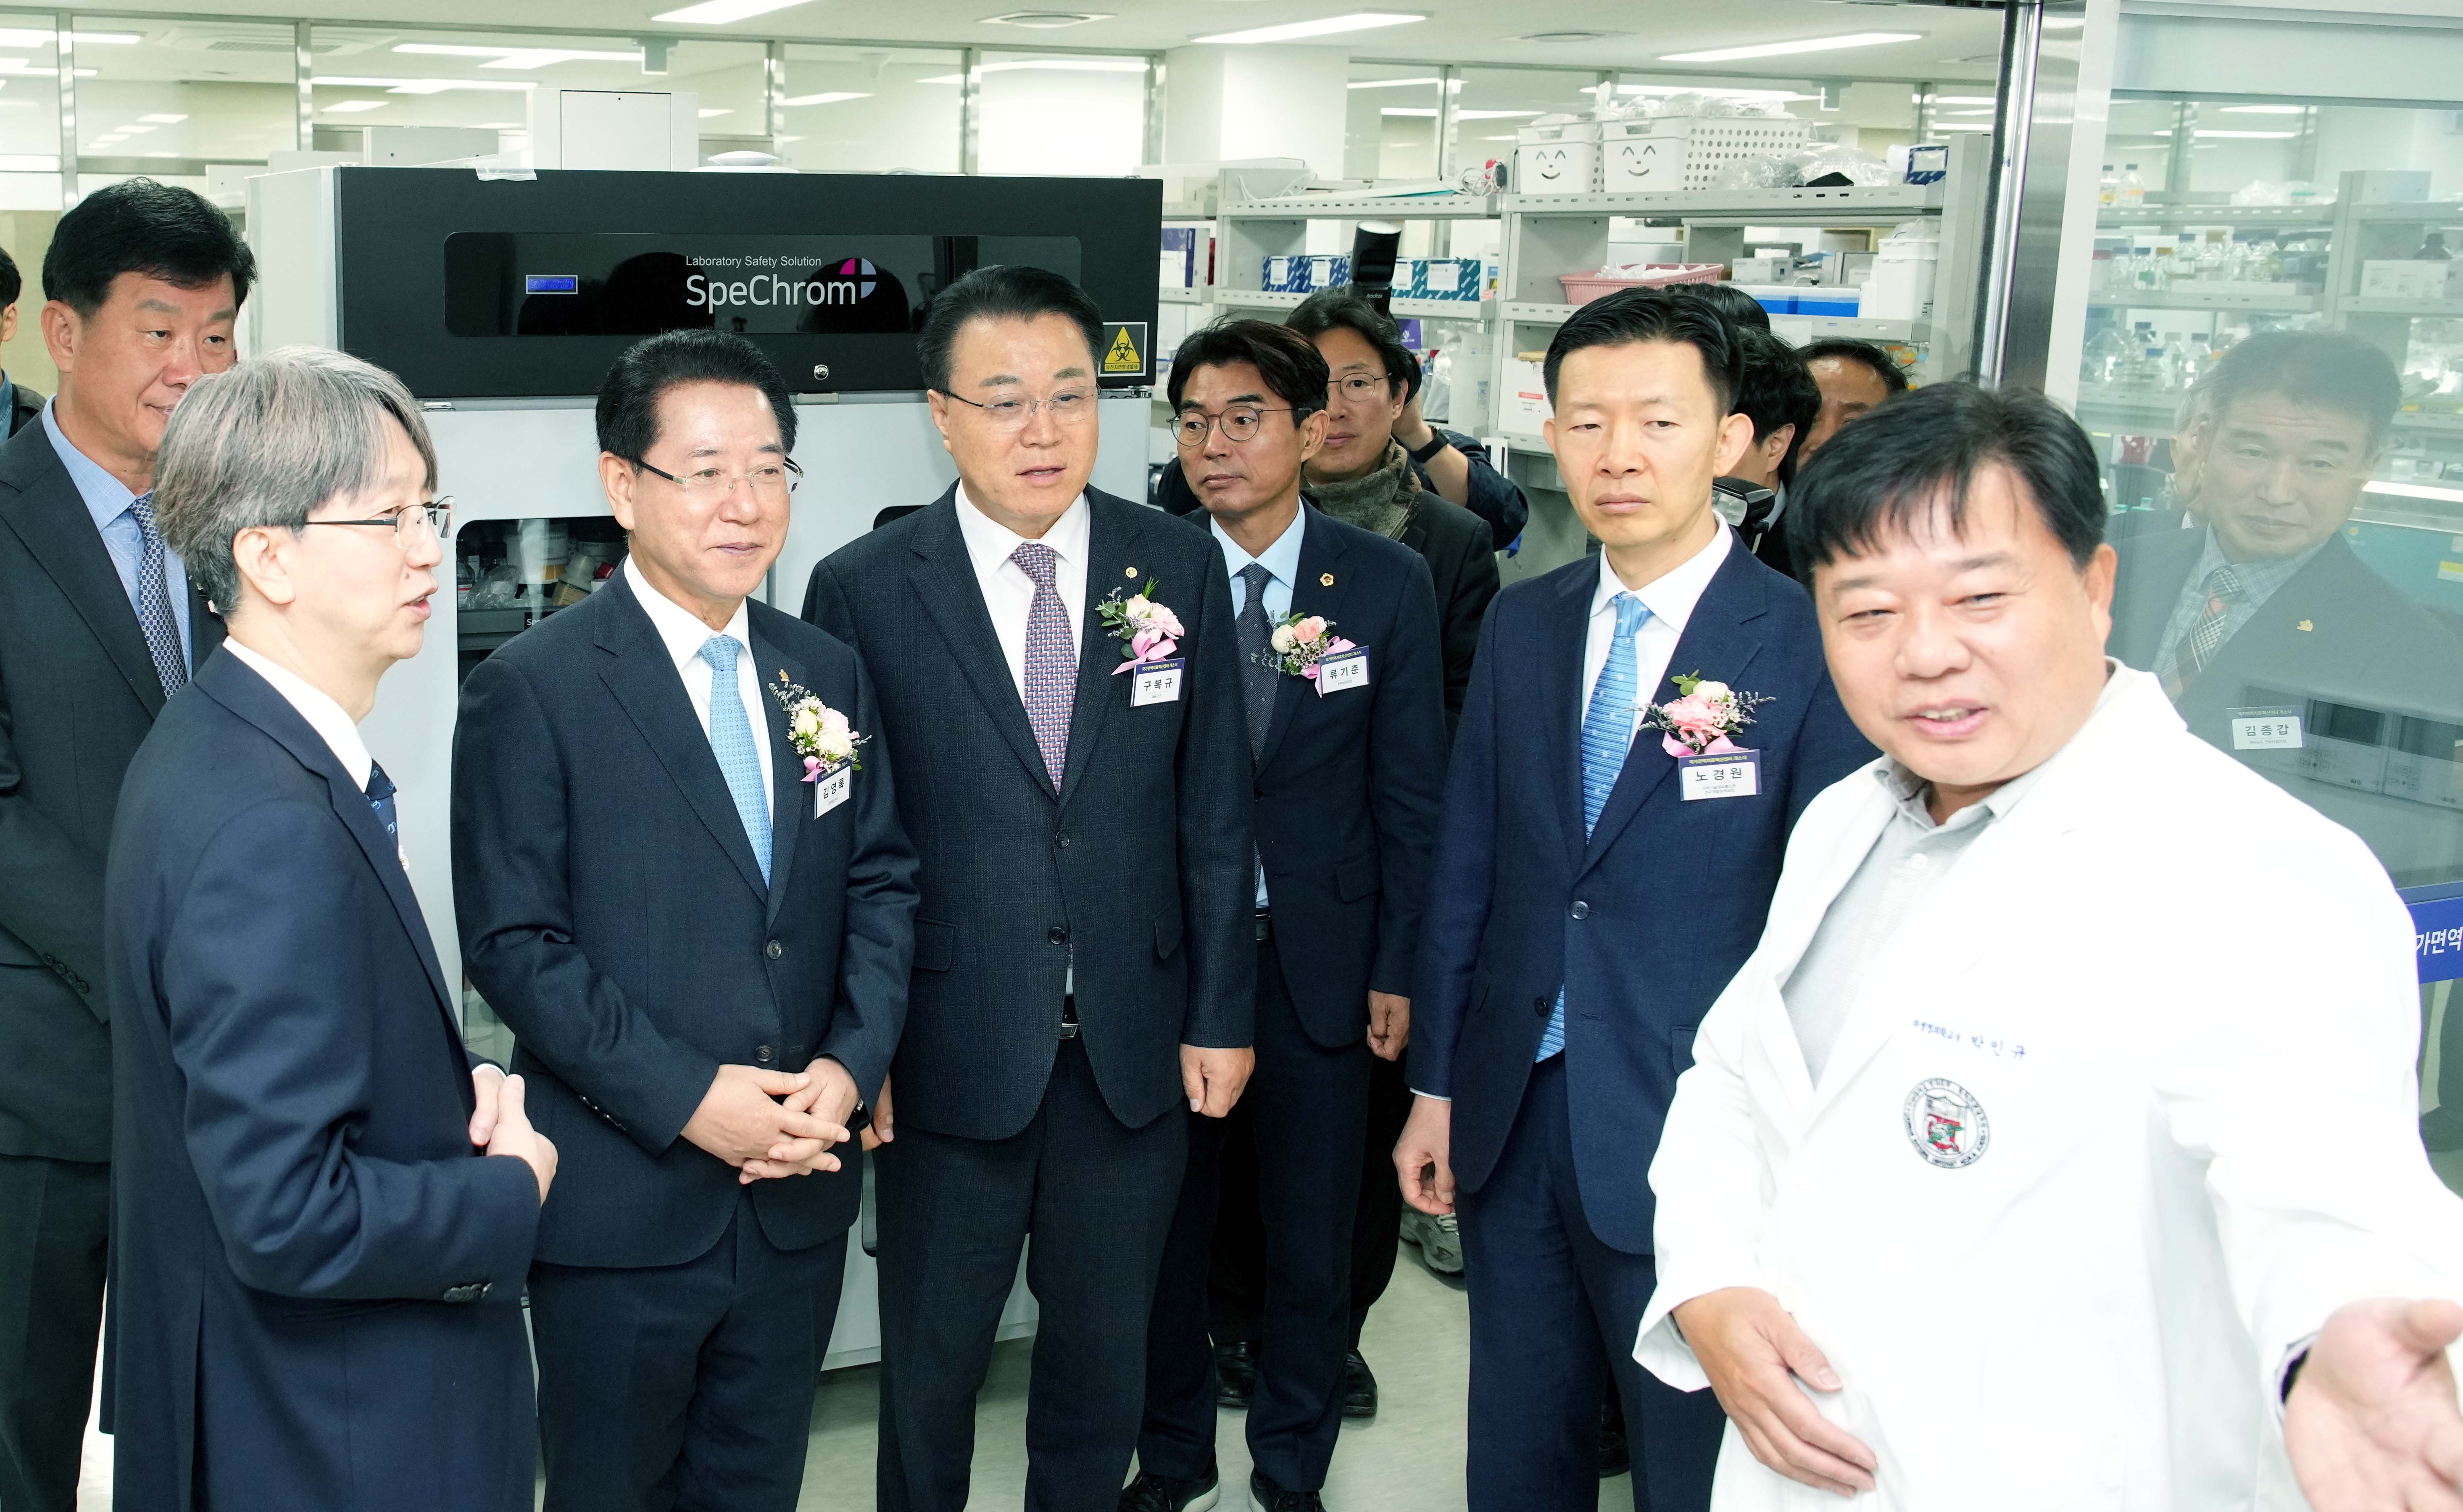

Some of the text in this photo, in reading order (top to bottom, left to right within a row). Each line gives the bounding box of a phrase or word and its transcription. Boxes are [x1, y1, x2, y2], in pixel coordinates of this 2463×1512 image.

[686, 255, 821, 268] Laboratory Safety Solution
[686, 274, 856, 314] SpeChrom
[1330, 665, 1359, 679] 류기준
[1143, 678, 1172, 692] 구복규
[2245, 724, 2289, 736] 김종갑
[1695, 767, 1742, 781] 노경원
[823, 777, 844, 799] 김영록
